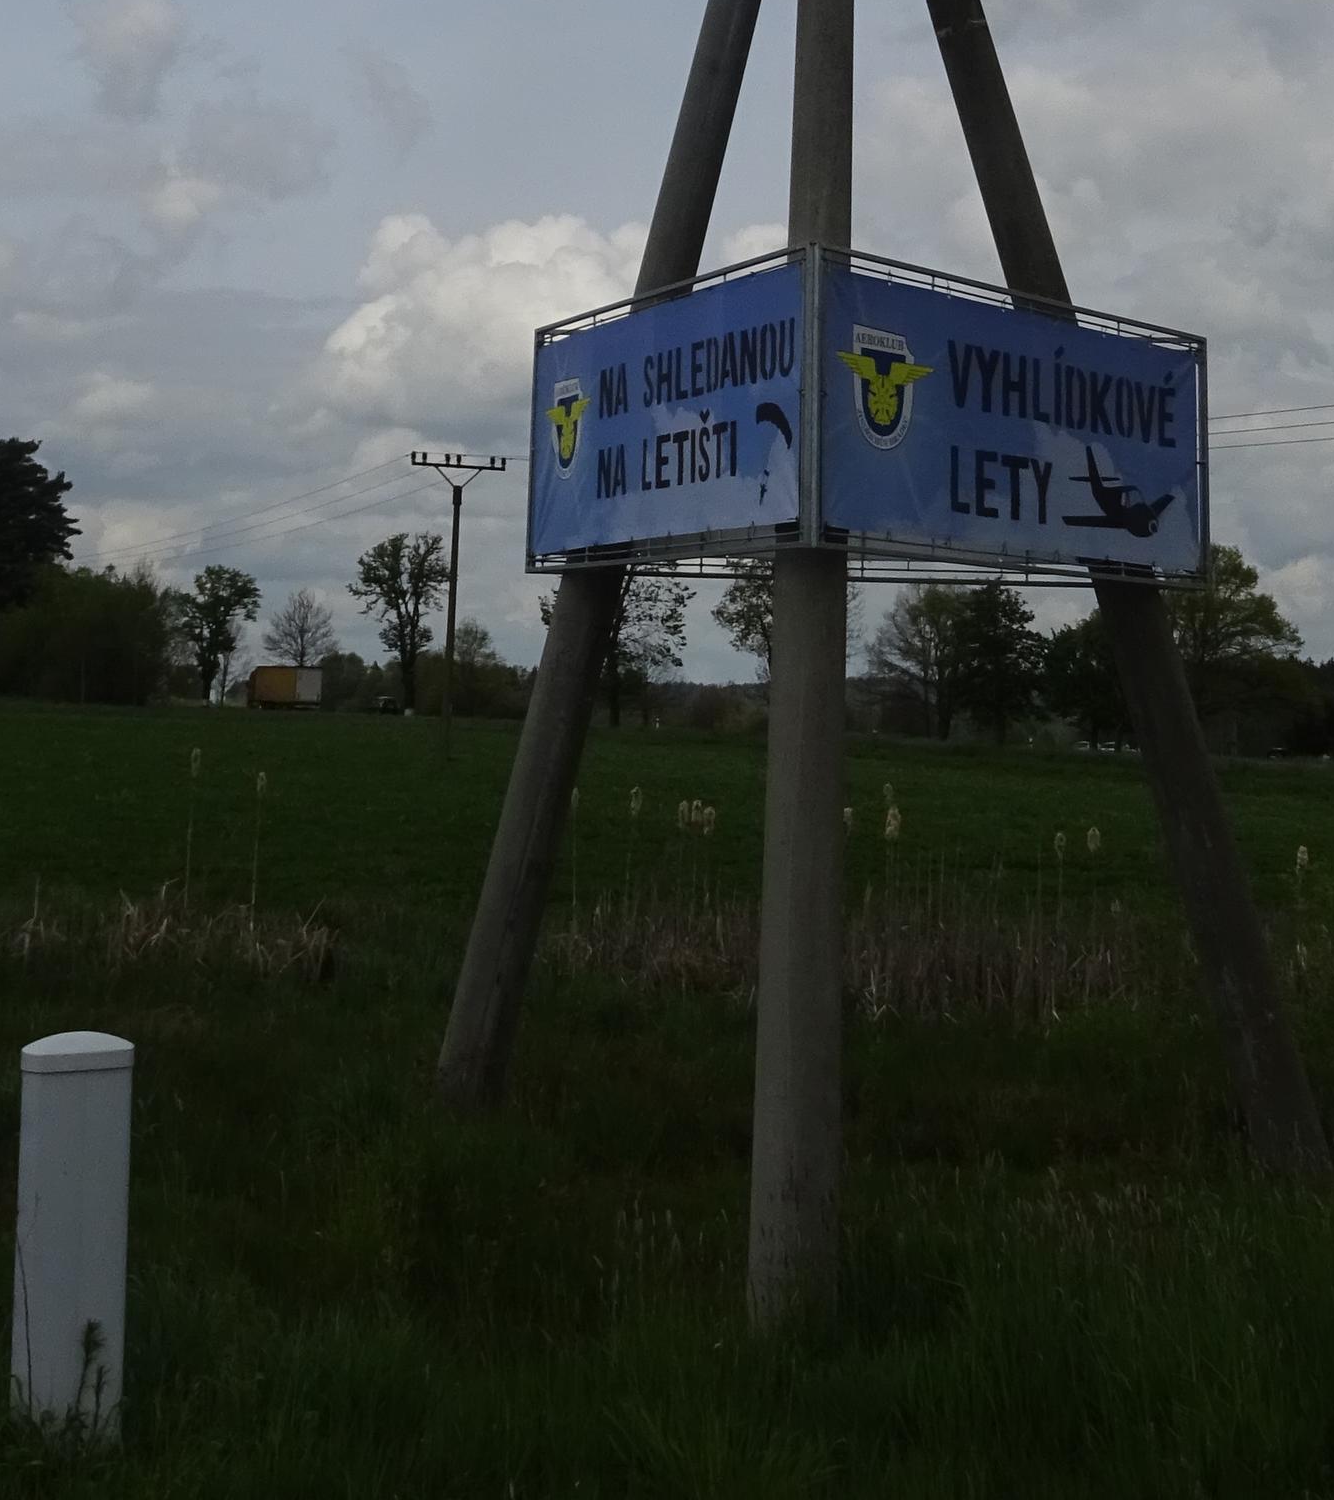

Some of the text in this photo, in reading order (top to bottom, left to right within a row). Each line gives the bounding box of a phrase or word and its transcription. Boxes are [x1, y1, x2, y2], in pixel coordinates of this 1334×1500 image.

[599, 318, 796, 419] NA SHLEDANOU
[854, 332, 905, 351] AEROKLUB
[948, 339, 1177, 448] VYHLÍDKOVÉ
[596, 410, 738, 499] NA LETIŠTI
[949, 445, 1052, 525] LETY
